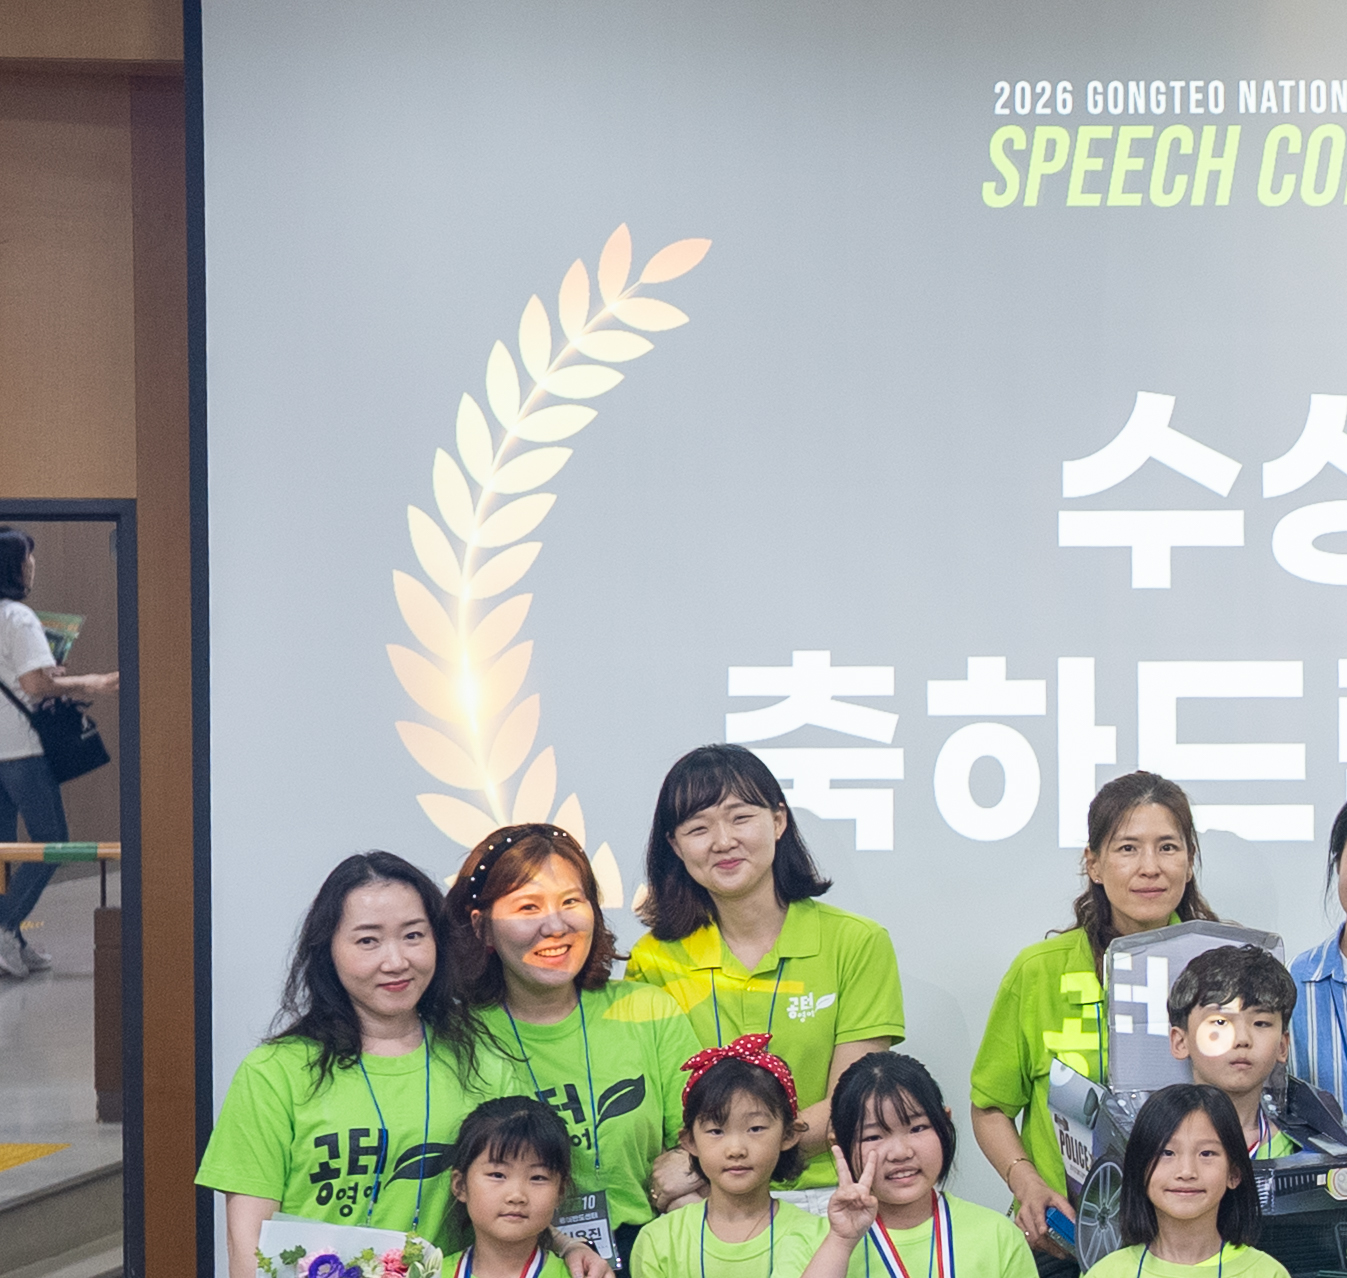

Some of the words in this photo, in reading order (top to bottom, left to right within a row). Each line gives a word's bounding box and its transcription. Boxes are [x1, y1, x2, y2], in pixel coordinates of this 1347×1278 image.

[994, 80, 1073, 115] 2026
[1087, 79, 1226, 114] GONGTEO
[982, 124, 1240, 208] SPEECH
[786, 992, 814, 1019] 공터
[797, 1010, 815, 1023] 영어
[310, 1128, 388, 1206] 공터
[336, 1181, 381, 1217] 영어
[582, 1195, 596, 1210] 10
